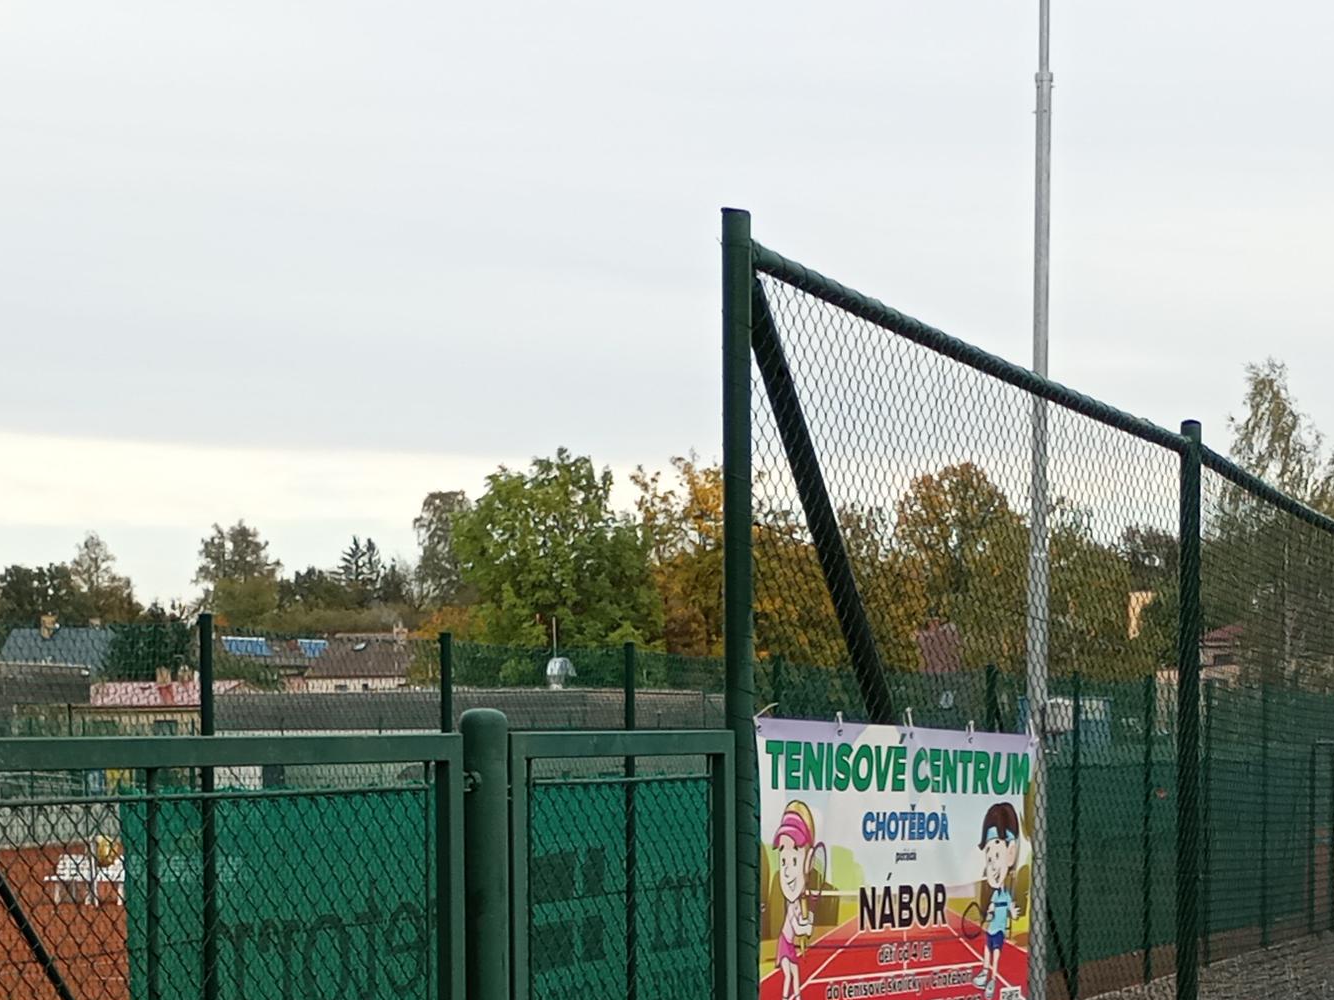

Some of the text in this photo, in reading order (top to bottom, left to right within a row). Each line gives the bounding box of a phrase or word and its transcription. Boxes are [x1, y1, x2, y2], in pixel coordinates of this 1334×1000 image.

[765, 733, 1030, 796] TENISOVÉ CENTRUM
[862, 804, 950, 842] CHOTĚBOŘ
[859, 872, 948, 931] NÁBOR
[826, 981, 840, 1000] do
[842, 979, 885, 999] tenisové
